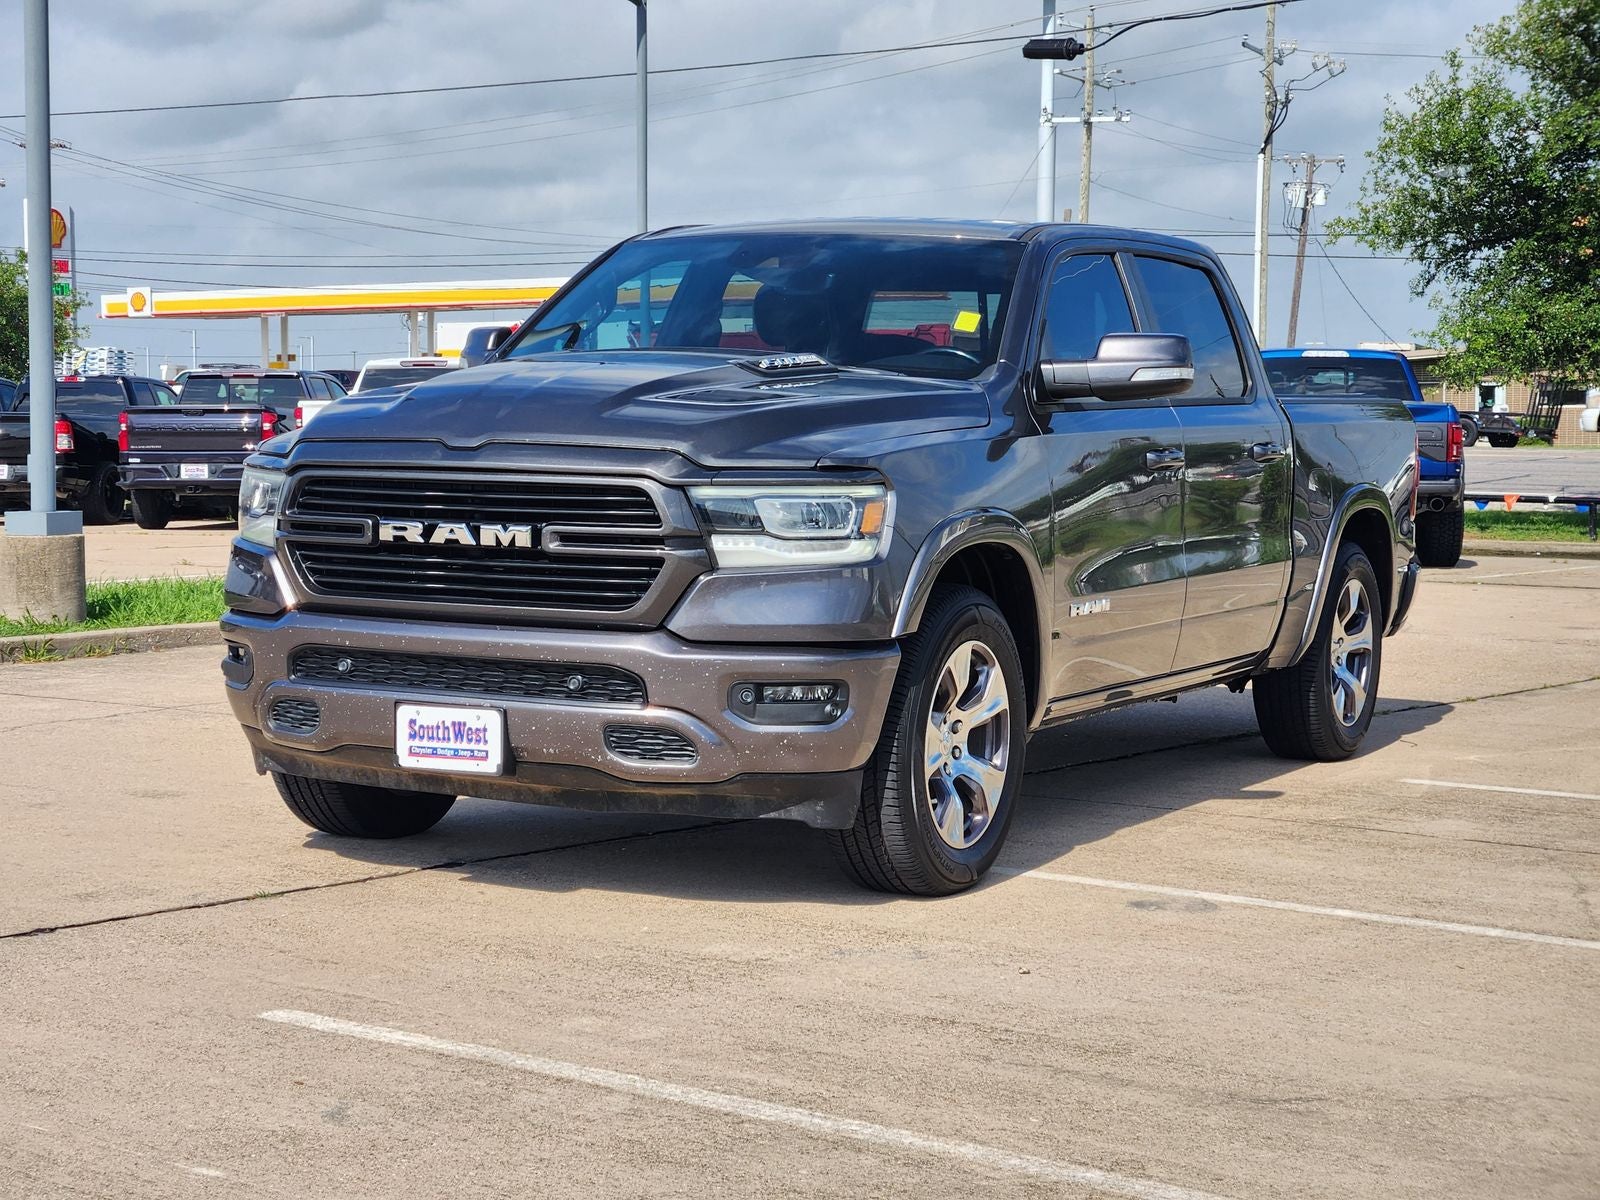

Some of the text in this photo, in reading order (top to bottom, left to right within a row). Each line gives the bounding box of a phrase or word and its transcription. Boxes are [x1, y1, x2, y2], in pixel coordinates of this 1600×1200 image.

[379, 517, 532, 548] RAM
[1069, 598, 1110, 617] RAM
[408, 718, 488, 746] SouthWest
[411, 747, 433, 756] Chrysler
[436, 748, 456, 757] Dodge
[458, 750, 472, 758] Jeep
